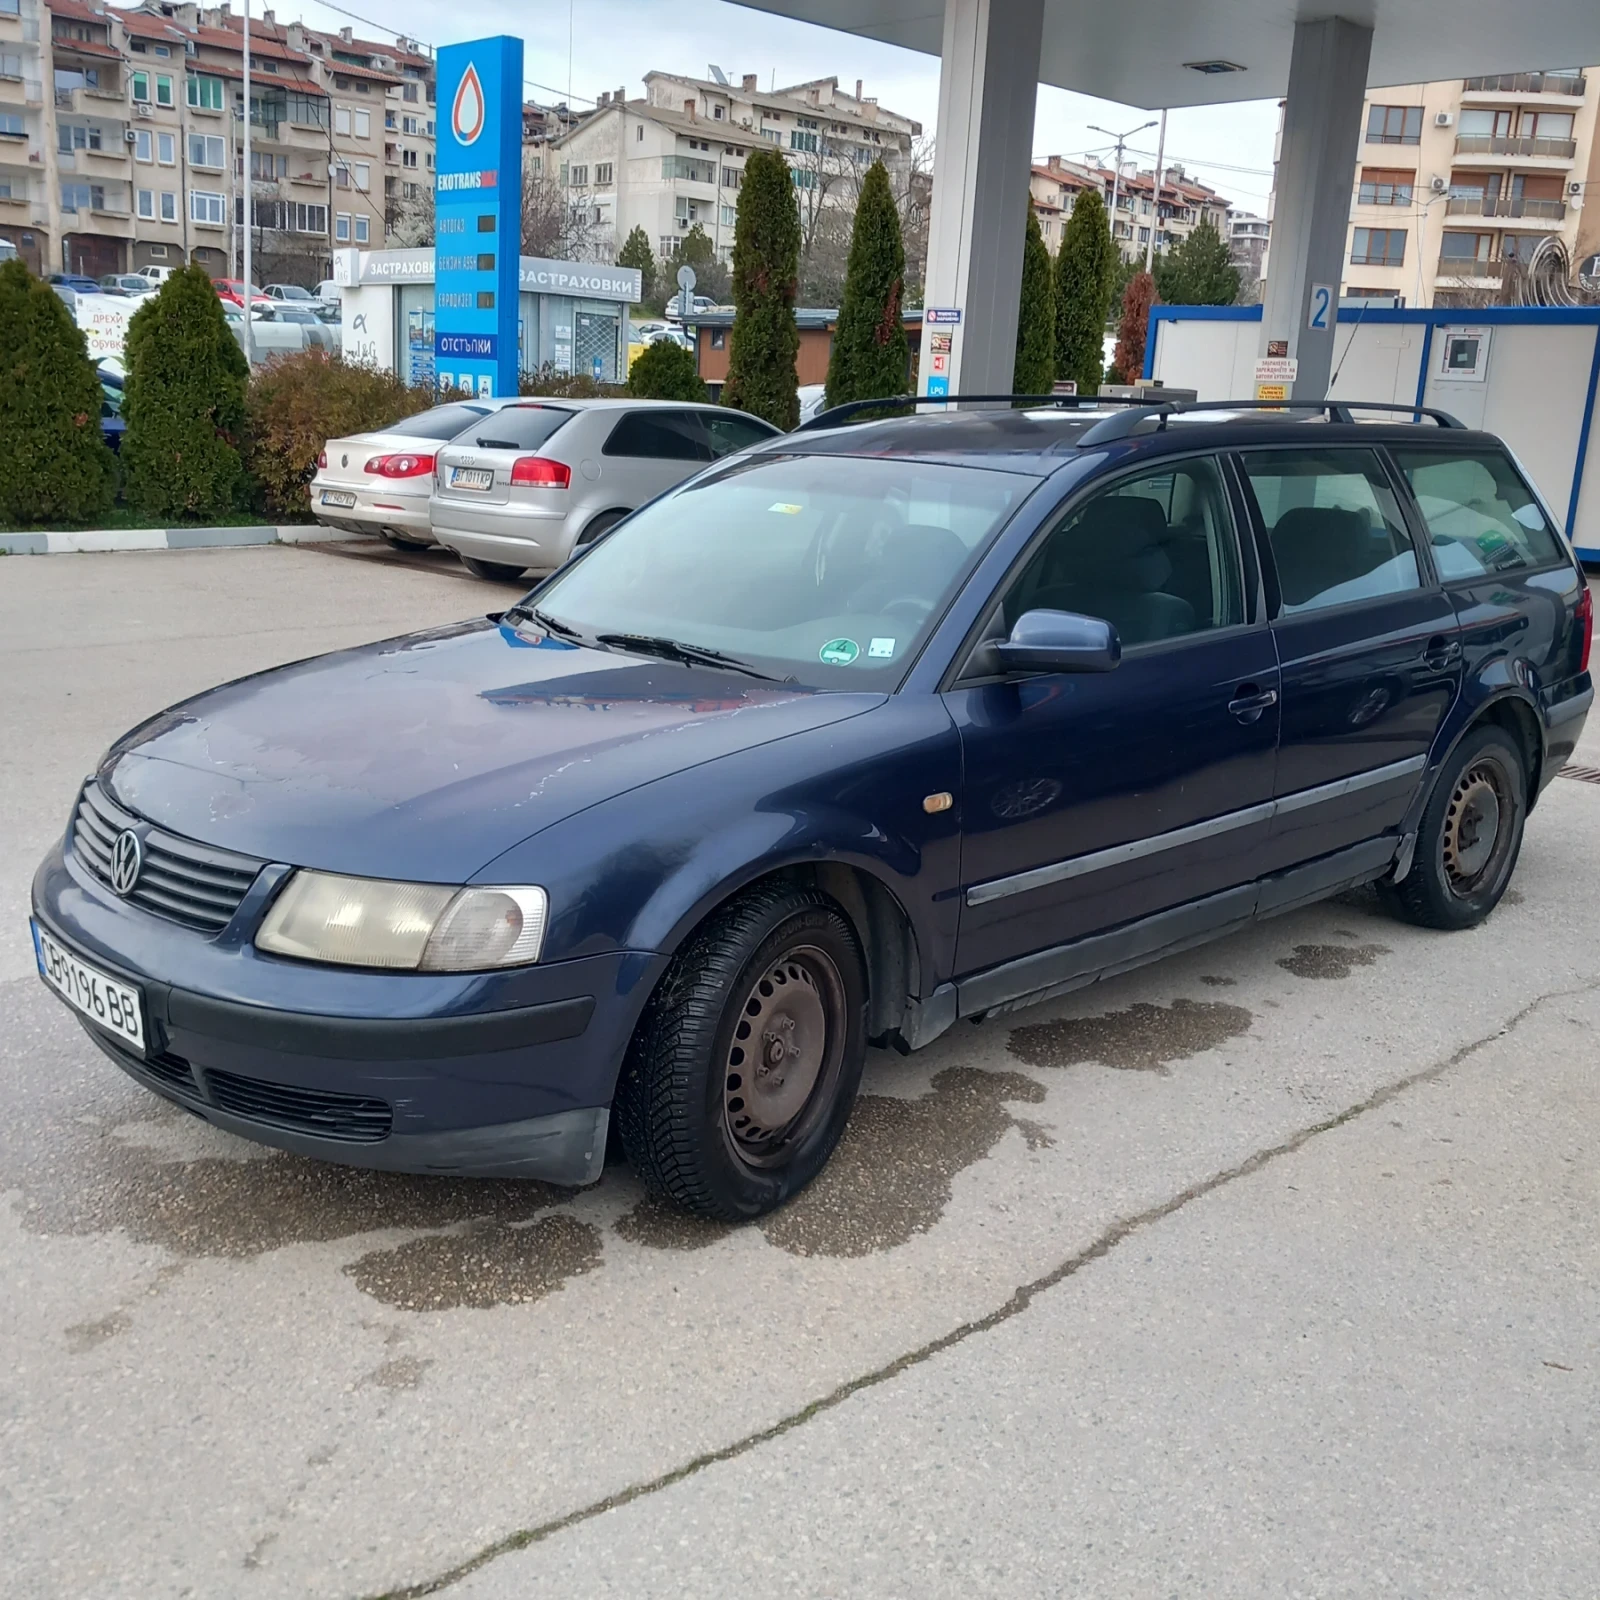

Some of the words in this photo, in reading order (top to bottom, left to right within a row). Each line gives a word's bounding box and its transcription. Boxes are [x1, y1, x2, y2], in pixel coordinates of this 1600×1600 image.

[370, 261, 435, 275] ЗАСТРАХОВК
[1312, 288, 1329, 328] 2
[93, 314, 123, 324] ДРЕХИ
[441, 337, 491, 354] ОТСТЪПКИ
[930, 387, 944, 395] LPG
[836, 640, 848, 653] 4
